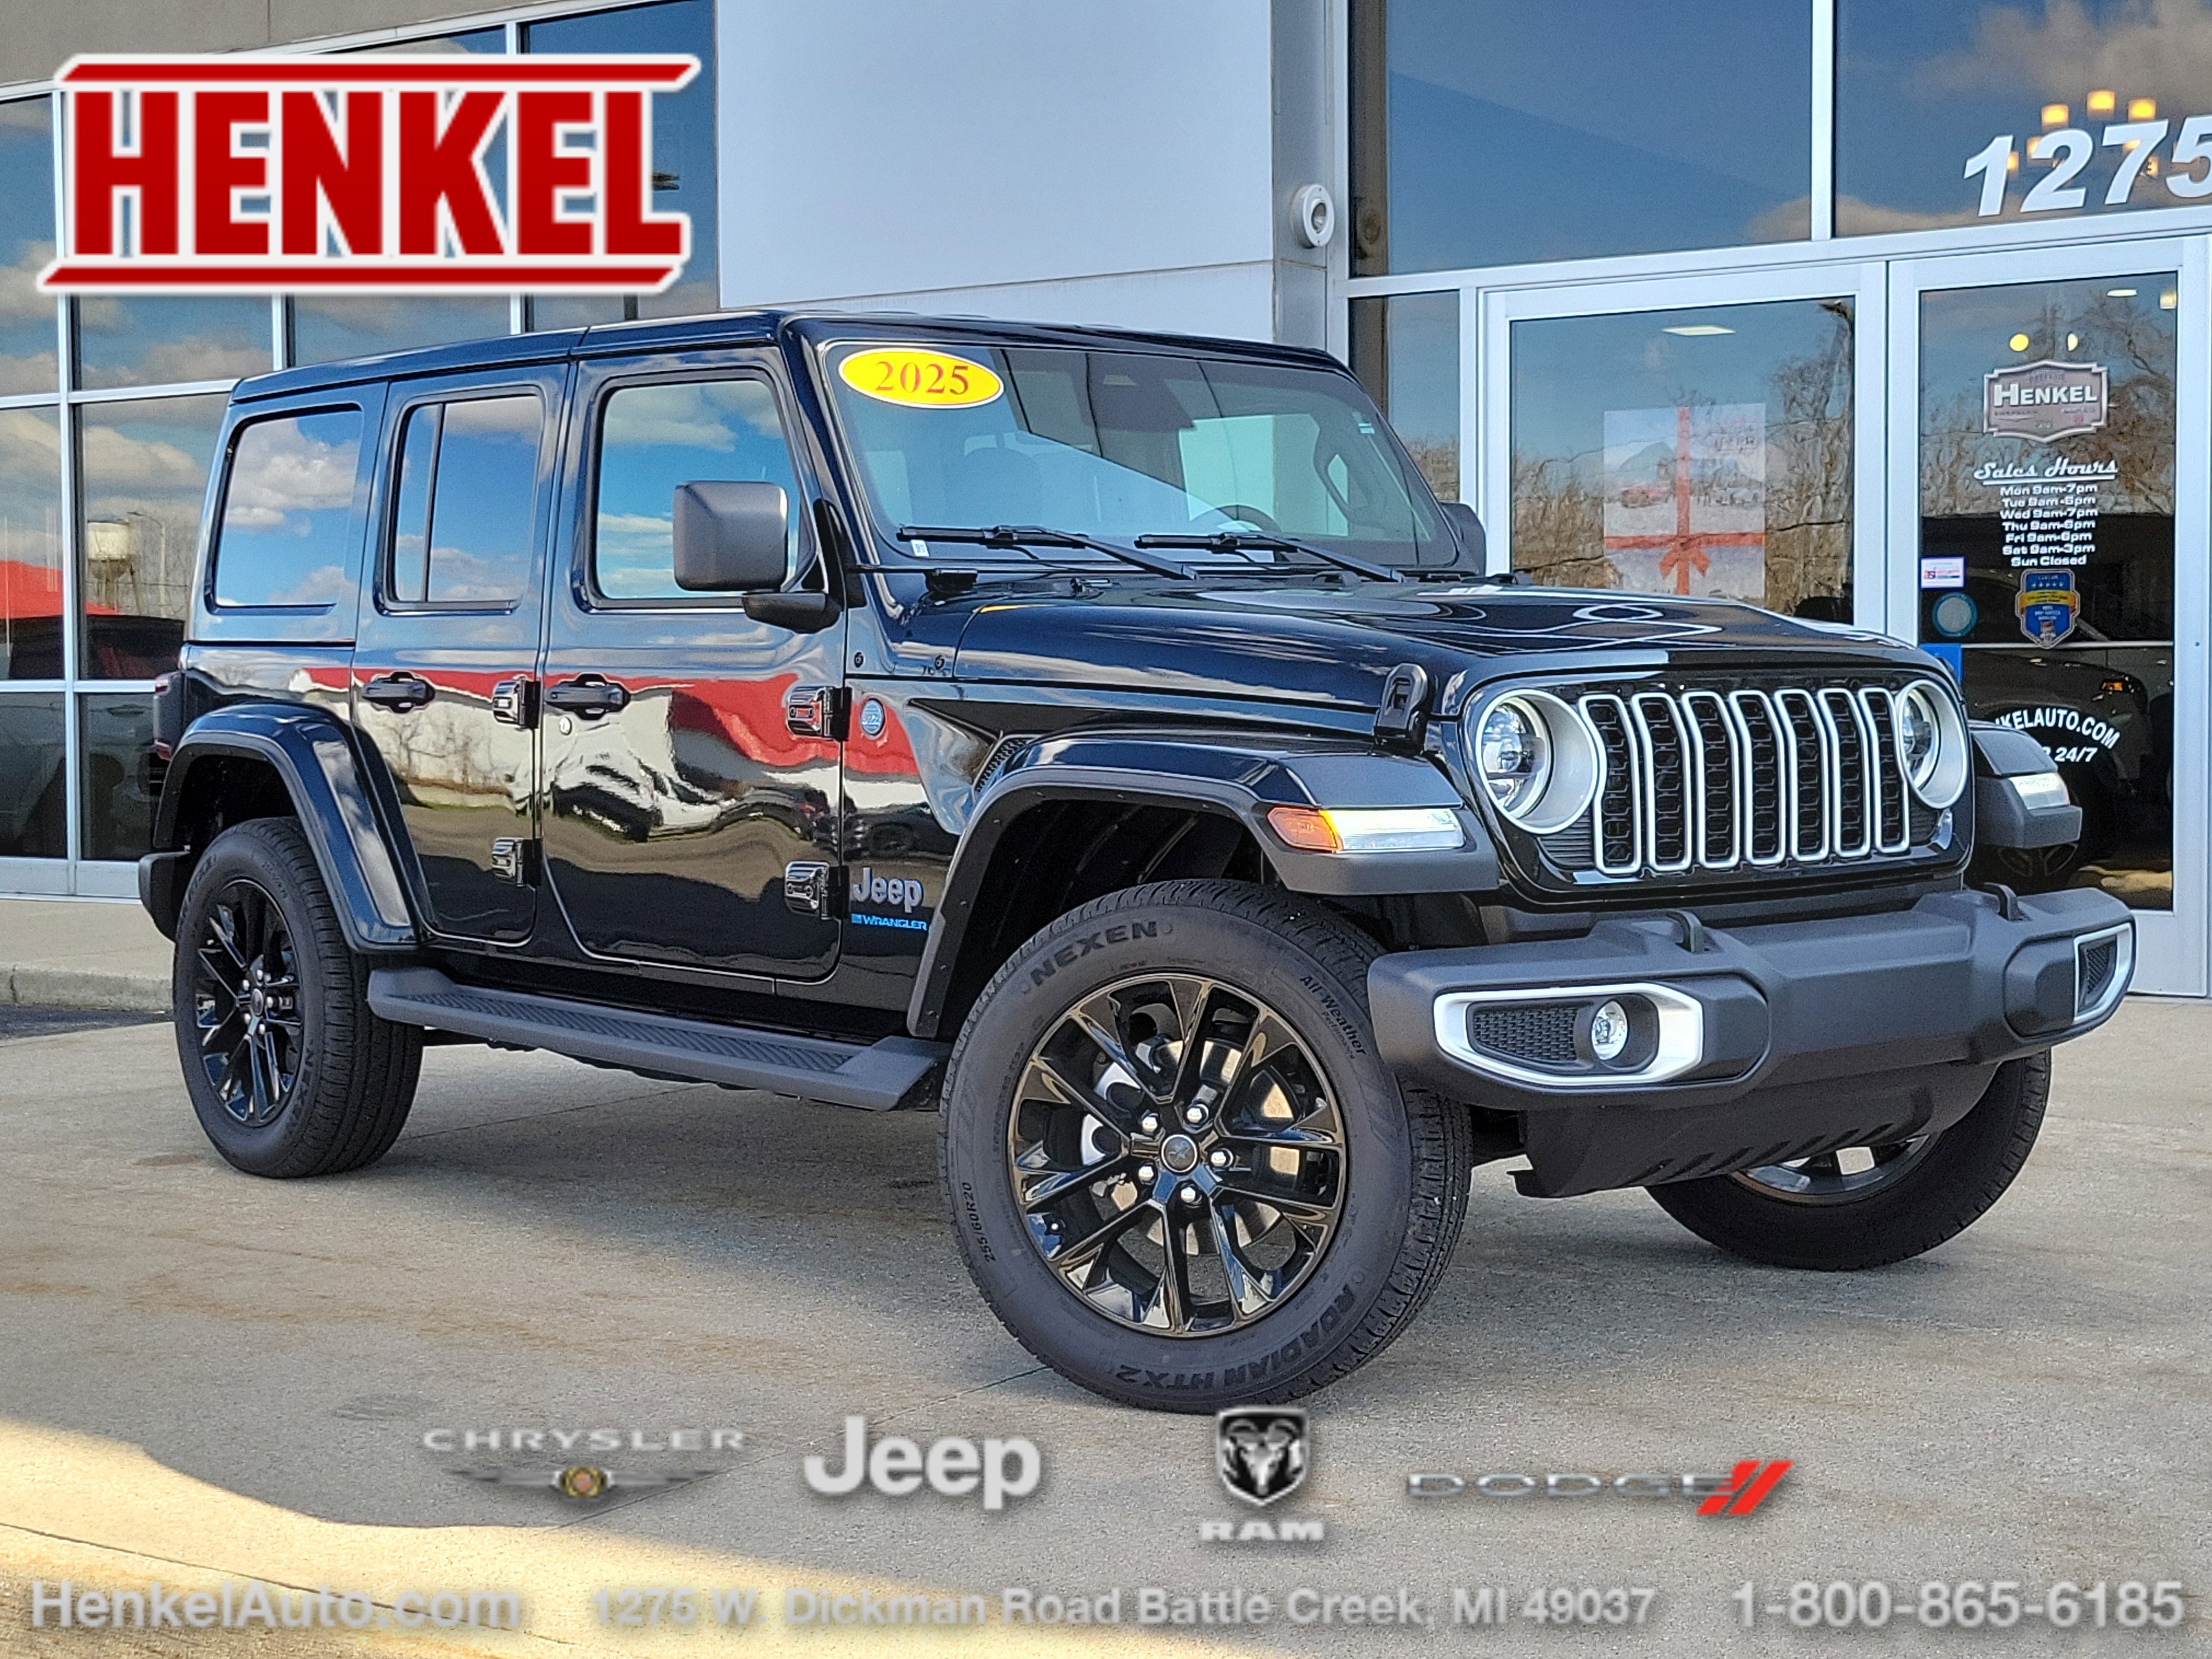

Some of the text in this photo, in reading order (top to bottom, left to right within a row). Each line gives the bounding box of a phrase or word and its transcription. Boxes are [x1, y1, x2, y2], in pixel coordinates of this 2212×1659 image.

[1963, 114, 2212, 217] 1275
[875, 361, 969, 395] 2025
[1994, 383, 2098, 407] HENKEL
[1974, 456, 2118, 480] Sales Hours
[2000, 483, 2098, 496] Mon 9am-7pm
[2001, 497, 2025, 508] Tue
[2000, 507, 2098, 520] Wed 9am-7pm
[2002, 521, 2028, 531] Thu
[2005, 533, 2025, 543] Fri
[2002, 545, 2028, 555] Sat
[2011, 555, 2087, 567] Sun Closed
[1995, 707, 2120, 749] KELAUTO.COM
[2054, 746, 2098, 763] 24/7
[853, 866, 924, 913] Jeep
[862, 915, 927, 931] WRANGLER
[1030, 921, 1158, 987] NEXEN
[962, 1182, 997, 1262] 255/60R20
[1115, 1283, 1355, 1390] ROADIAN HTX2
